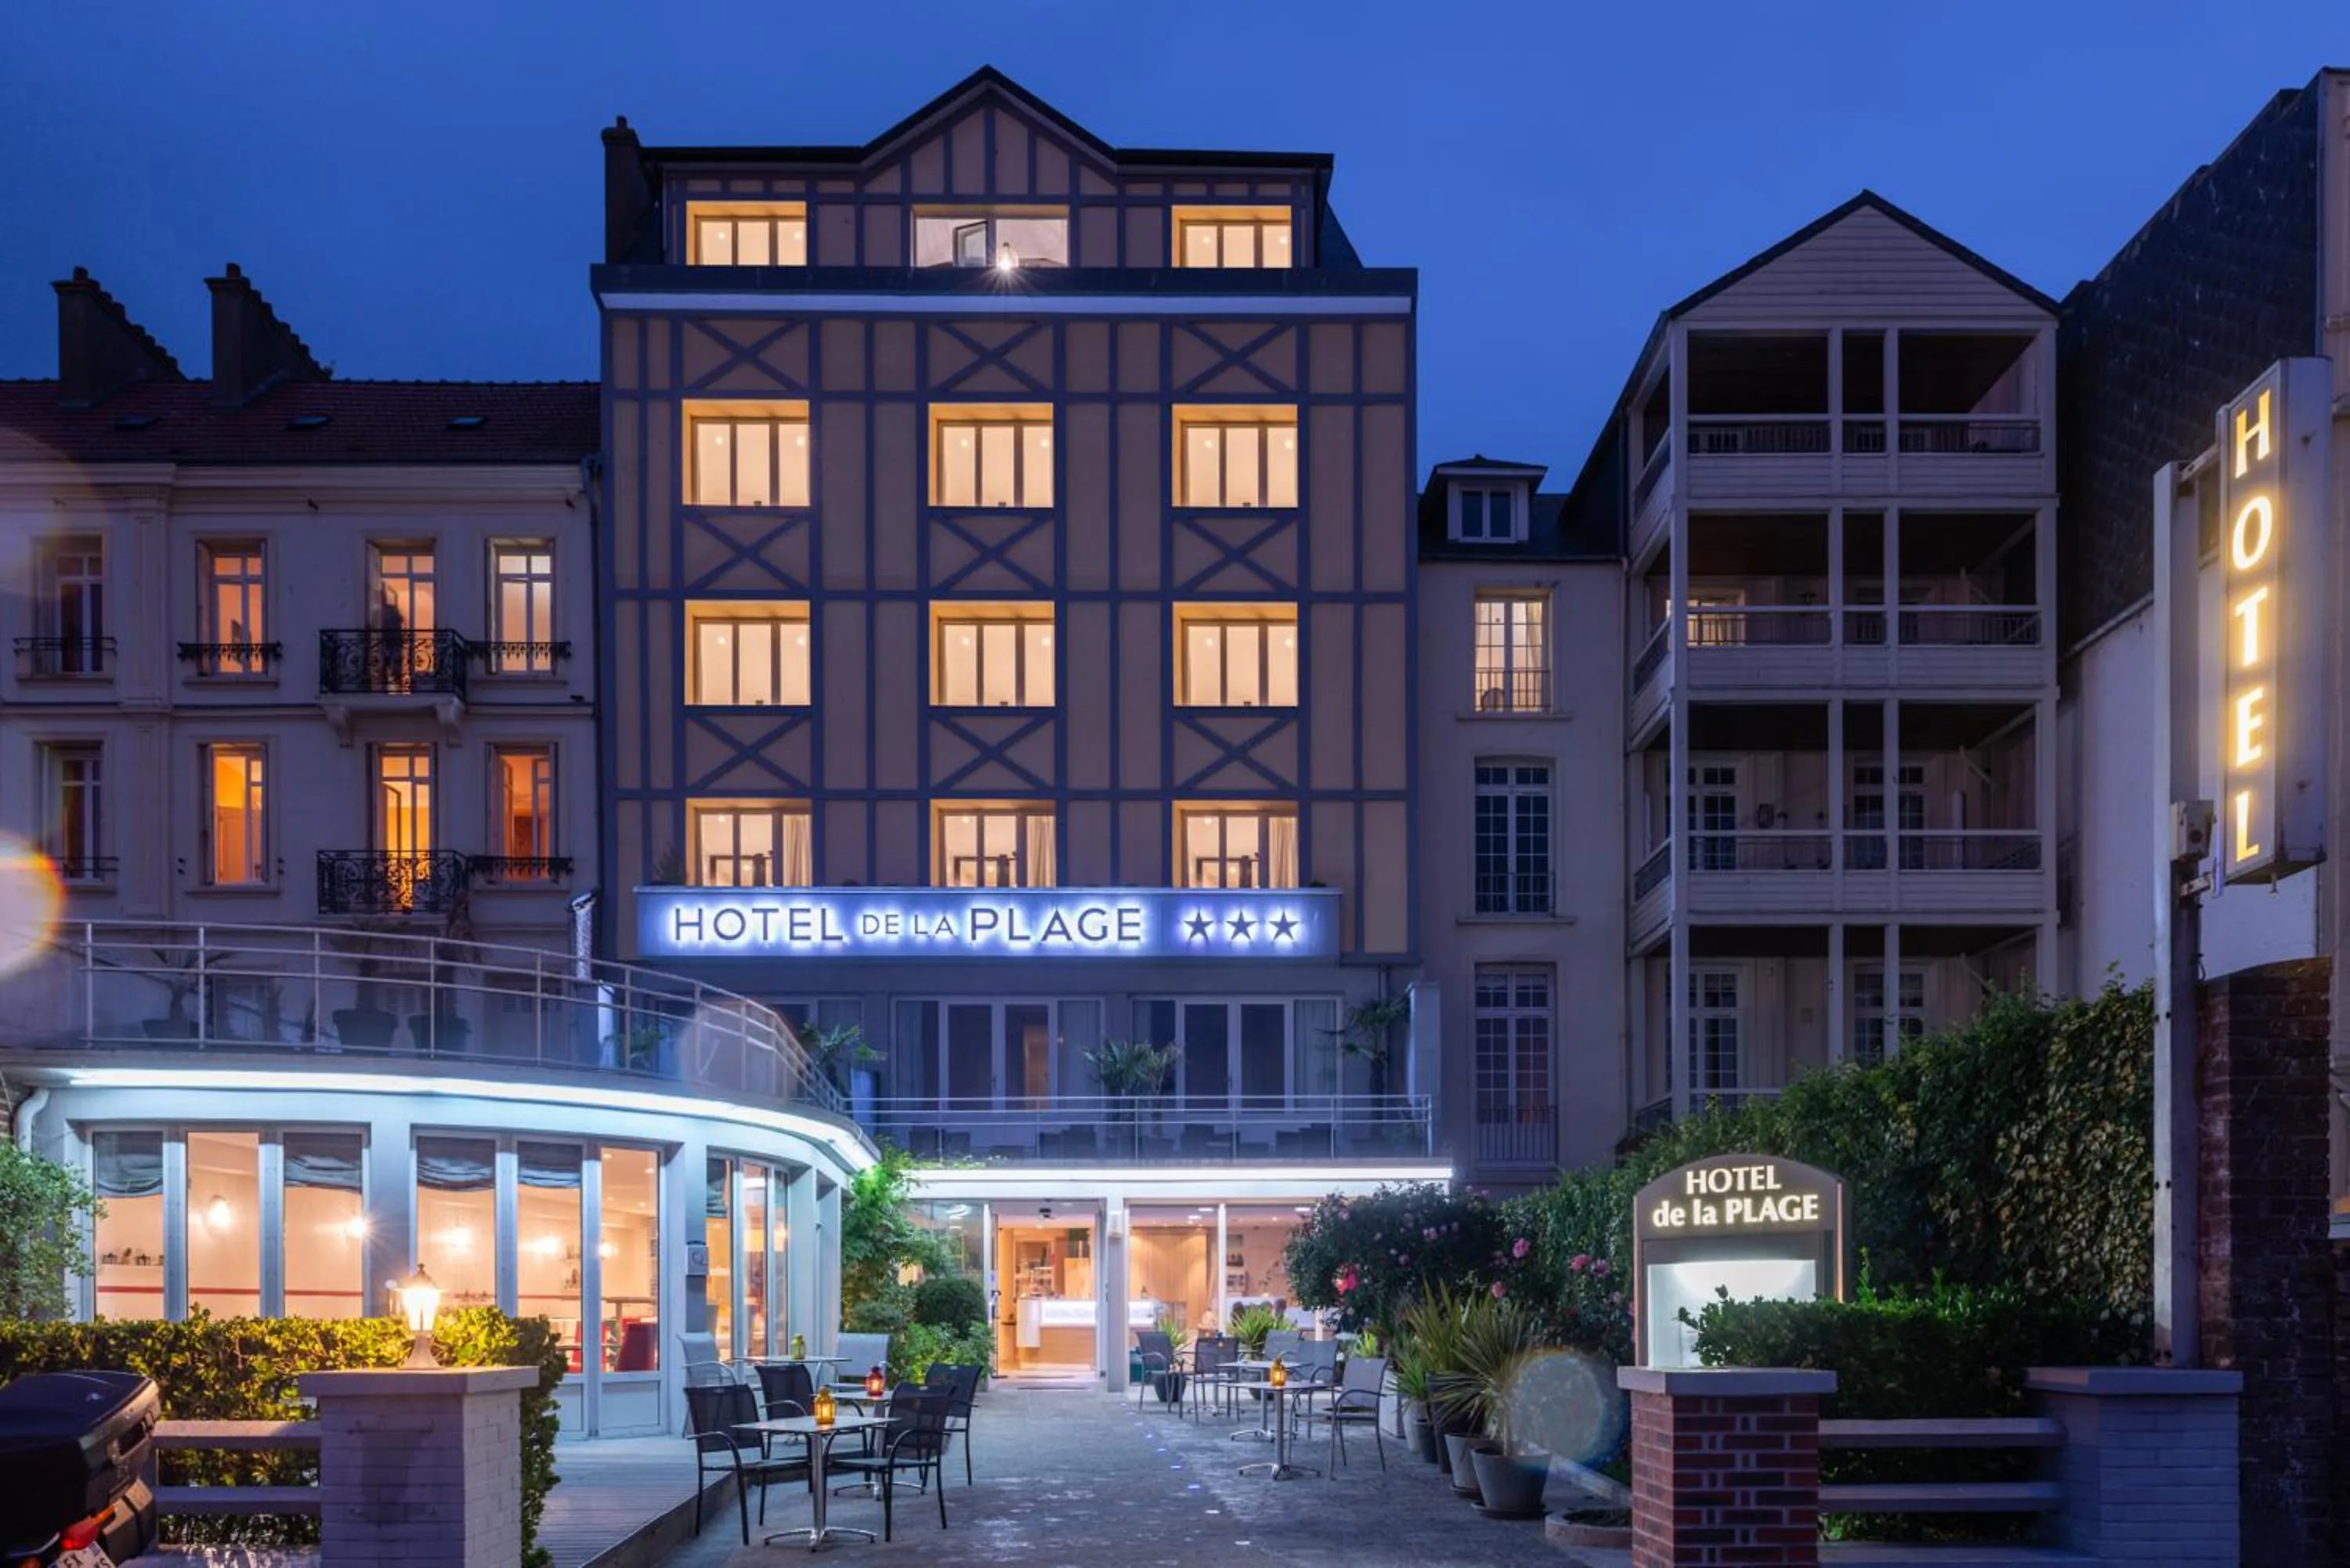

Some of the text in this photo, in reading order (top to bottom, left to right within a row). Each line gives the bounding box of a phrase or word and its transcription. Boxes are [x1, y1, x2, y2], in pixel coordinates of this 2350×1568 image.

[2232, 388, 2273, 863] HOTEL
[675, 907, 1141, 942] HOTEL DE LA PLAGE
[1686, 1165, 1782, 1195] HOTEL
[1652, 1194, 1819, 1228] de la PLAGE
